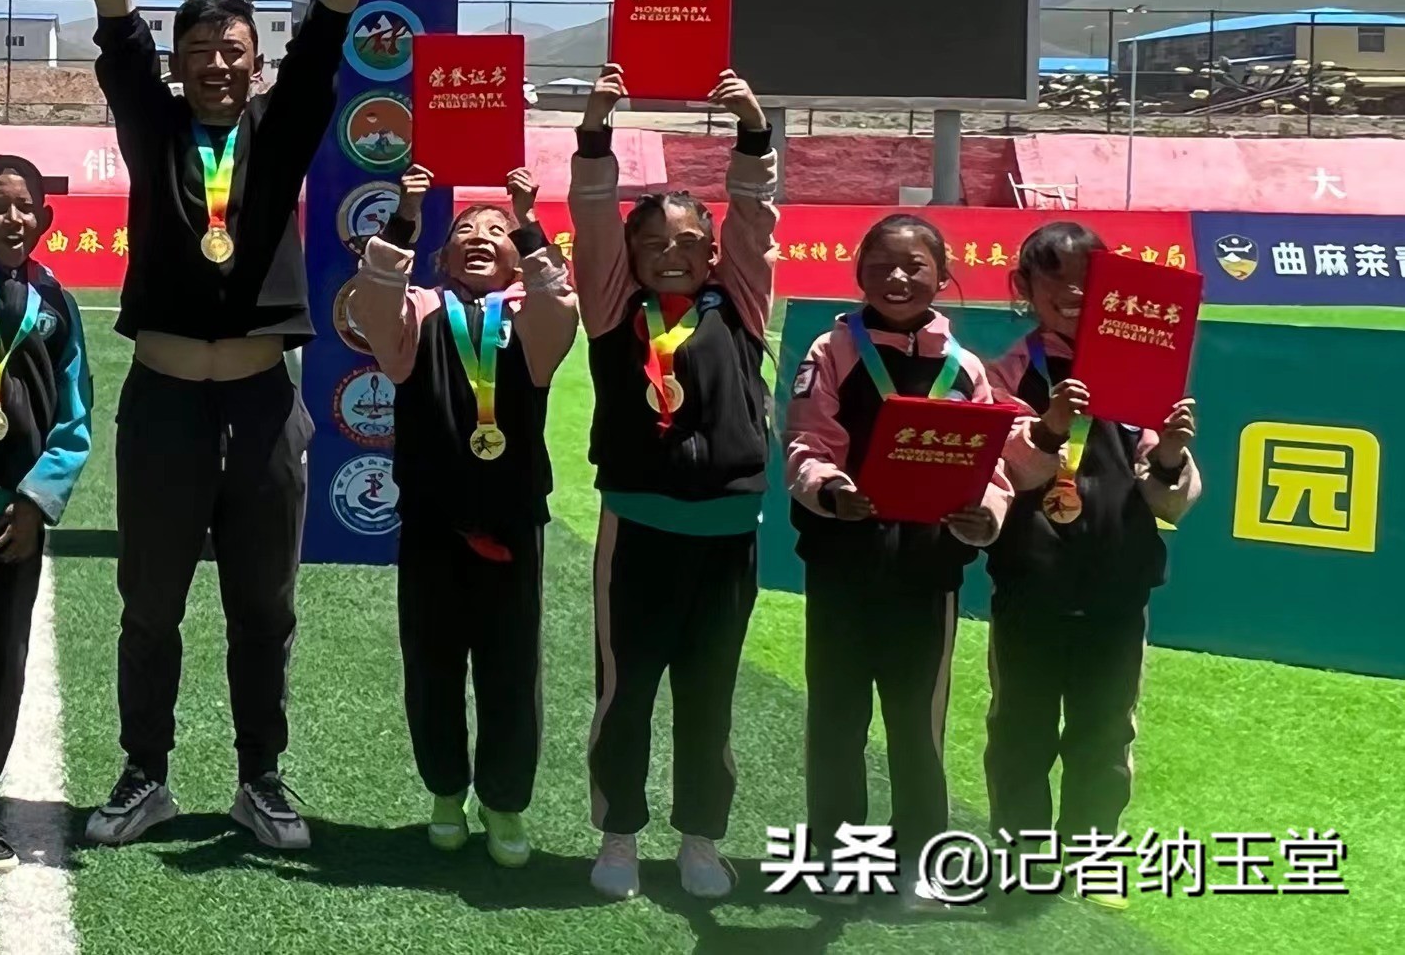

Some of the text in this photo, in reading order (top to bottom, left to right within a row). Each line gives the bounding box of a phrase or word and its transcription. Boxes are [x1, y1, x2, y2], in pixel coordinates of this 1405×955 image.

[629, 12, 712, 22] CREDENTIAL
[634, 5, 707, 14] HONORARY
[428, 65, 507, 87] 荣誉证书
[1308, 167, 1347, 199] 大
[1102, 290, 1183, 325] 荣誉证书
[1233, 421, 1380, 553] 园
